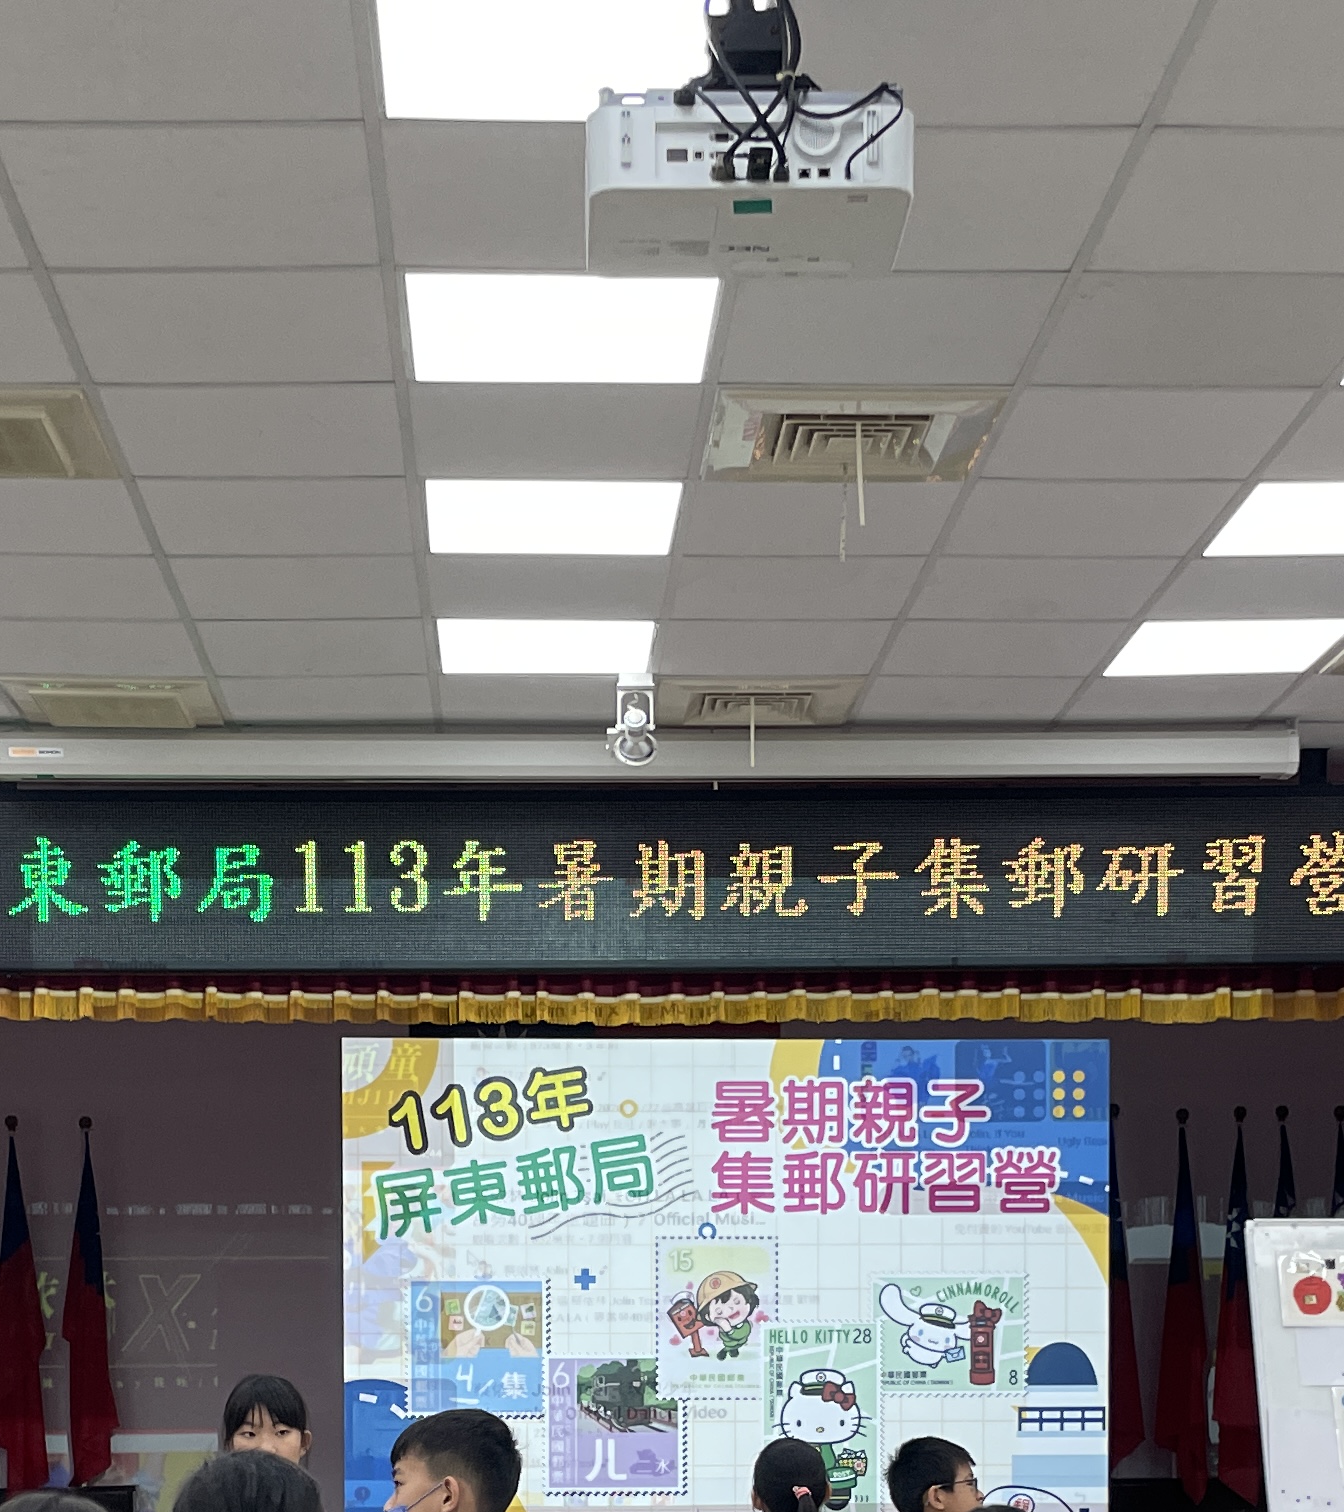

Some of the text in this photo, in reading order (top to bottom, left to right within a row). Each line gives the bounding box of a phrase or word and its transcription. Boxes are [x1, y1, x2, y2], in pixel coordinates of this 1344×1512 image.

[388, 1066, 594, 1155] 113年
[711, 1080, 987, 1144] 暑期親子
[372, 1135, 654, 1240] 屏東郵局
[711, 1151, 1056, 1214] 集郵研習營
[670, 1249, 693, 1271] 15
[415, 1286, 433, 1313] 6
[935, 1281, 1020, 1313] CINNAMOROLL
[769, 1329, 850, 1344] HELLO KITTY
[852, 1328, 873, 1344] 28
[552, 1362, 570, 1389] 6
[1008, 1370, 1018, 1385] 8
